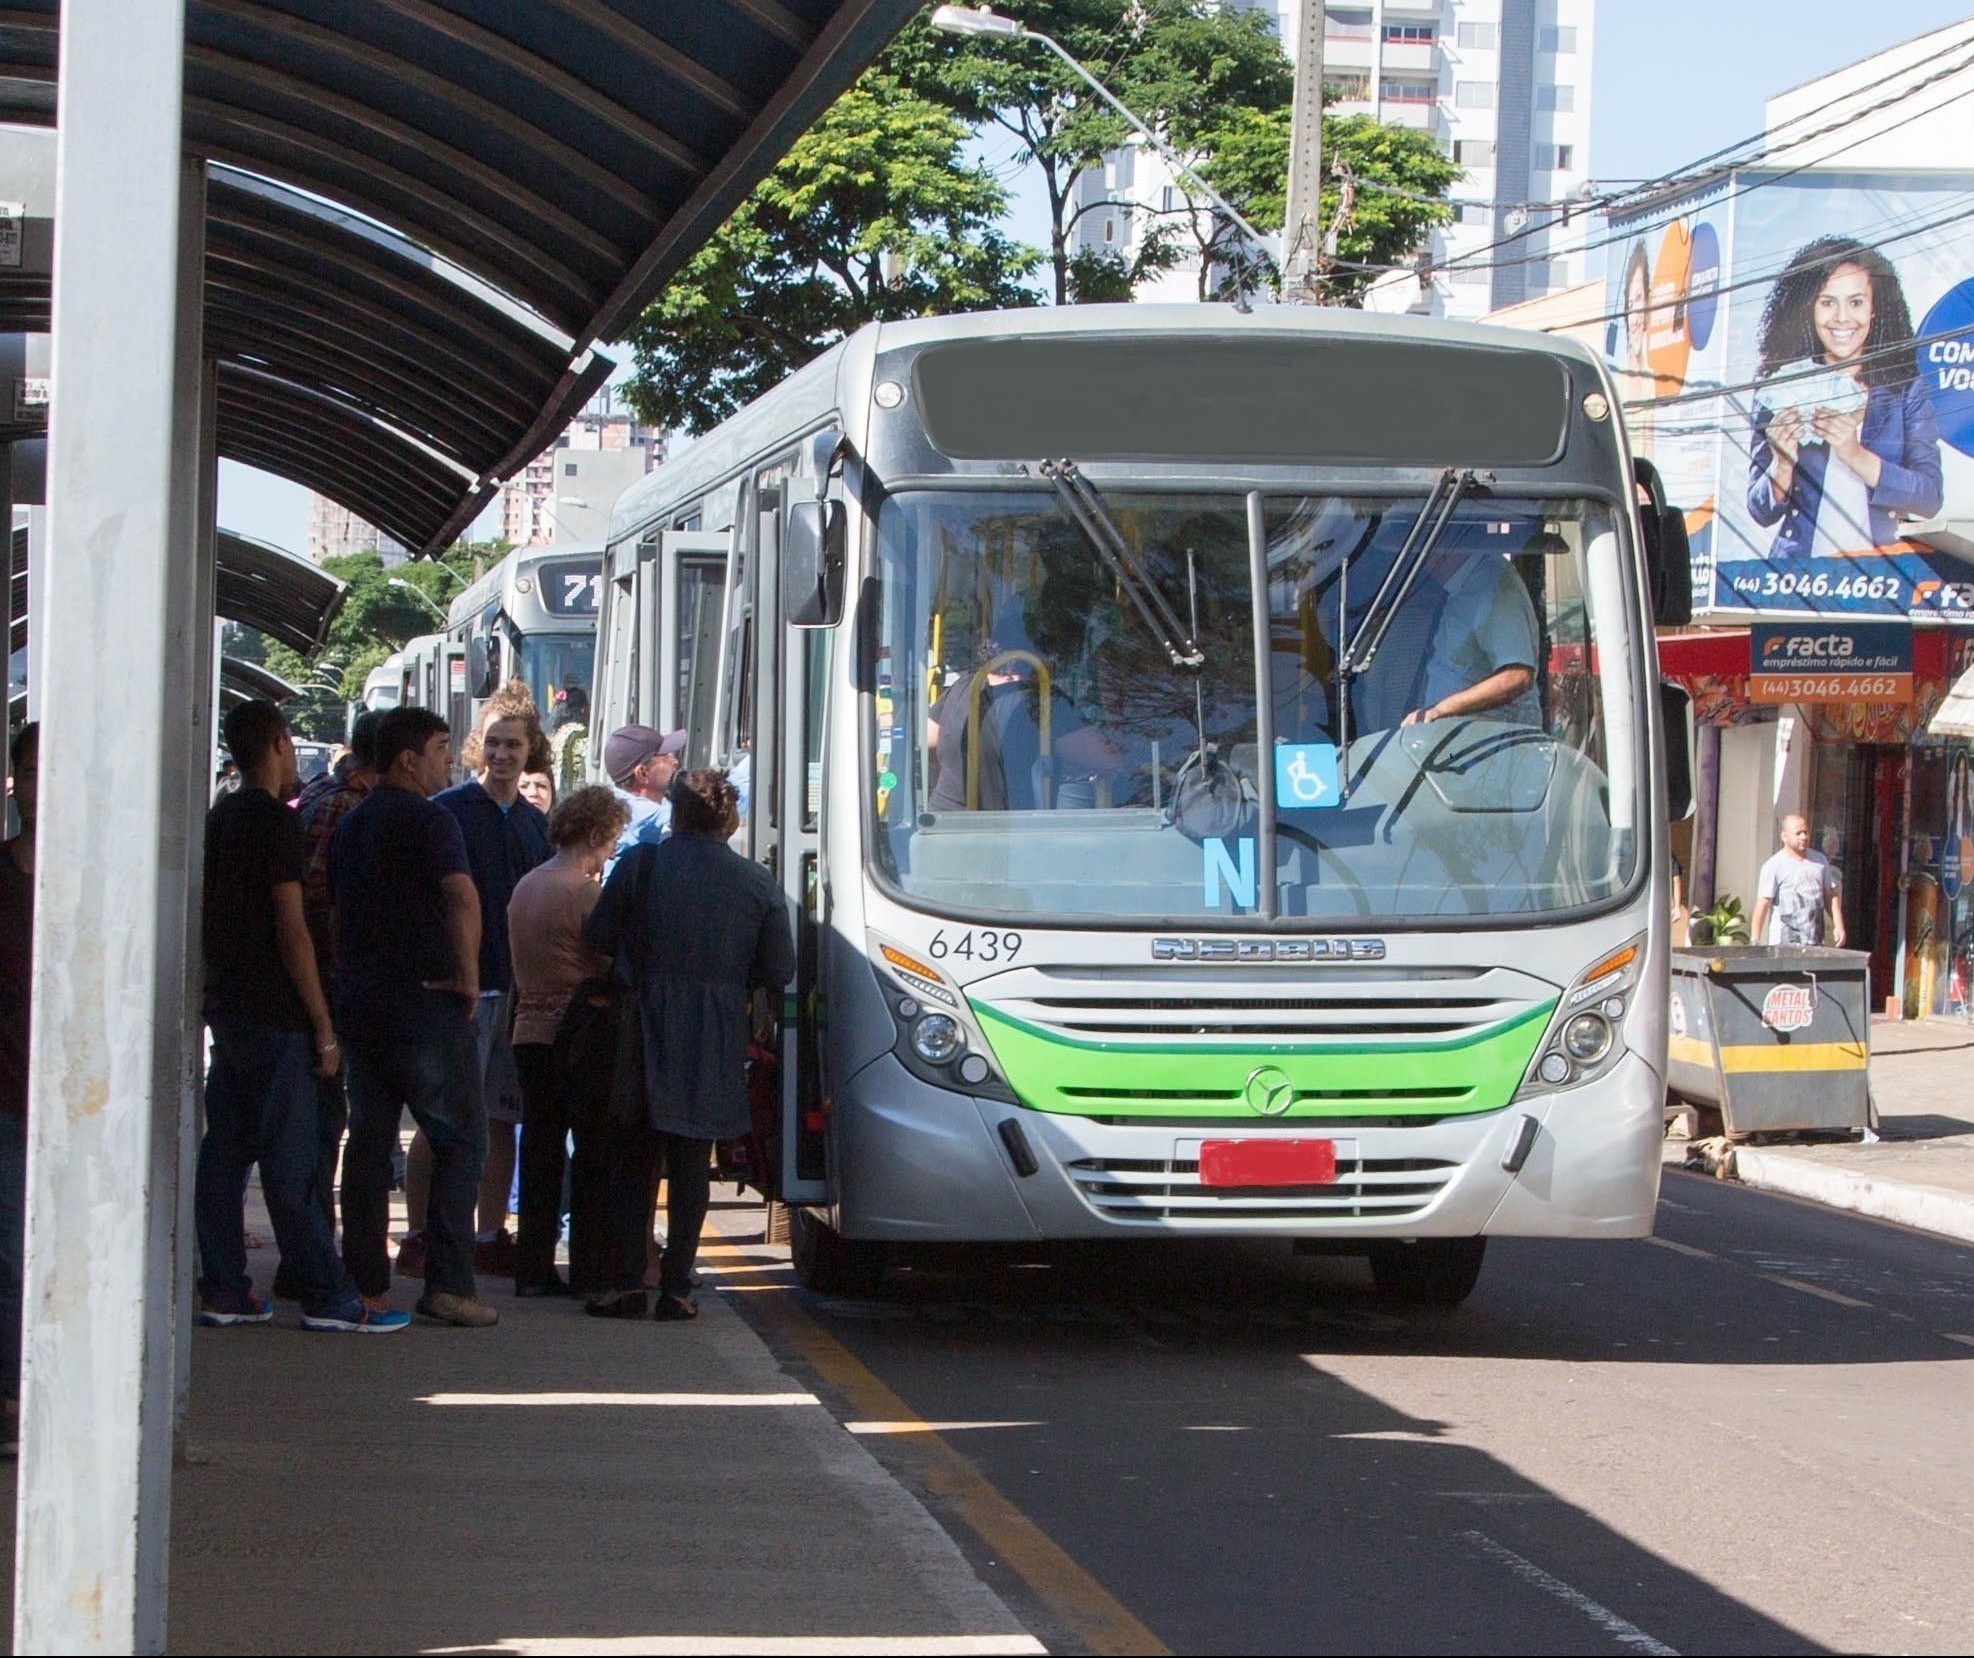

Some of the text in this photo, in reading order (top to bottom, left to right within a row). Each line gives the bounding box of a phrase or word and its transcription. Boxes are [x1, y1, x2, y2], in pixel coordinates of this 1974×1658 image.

[1939, 368, 1974, 391] VO
[1762, 572, 1900, 600] 3046.4662
[1786, 633, 1854, 656] facta
[1763, 655, 1898, 668] empréstimo rápido e fácil
[1203, 837, 1255, 907] N
[929, 929, 1023, 962] 6439
[1152, 938, 1386, 961] NEOBUS
[1770, 990, 1808, 1007] METAL
[1764, 1009, 1810, 1025] SANTOS
